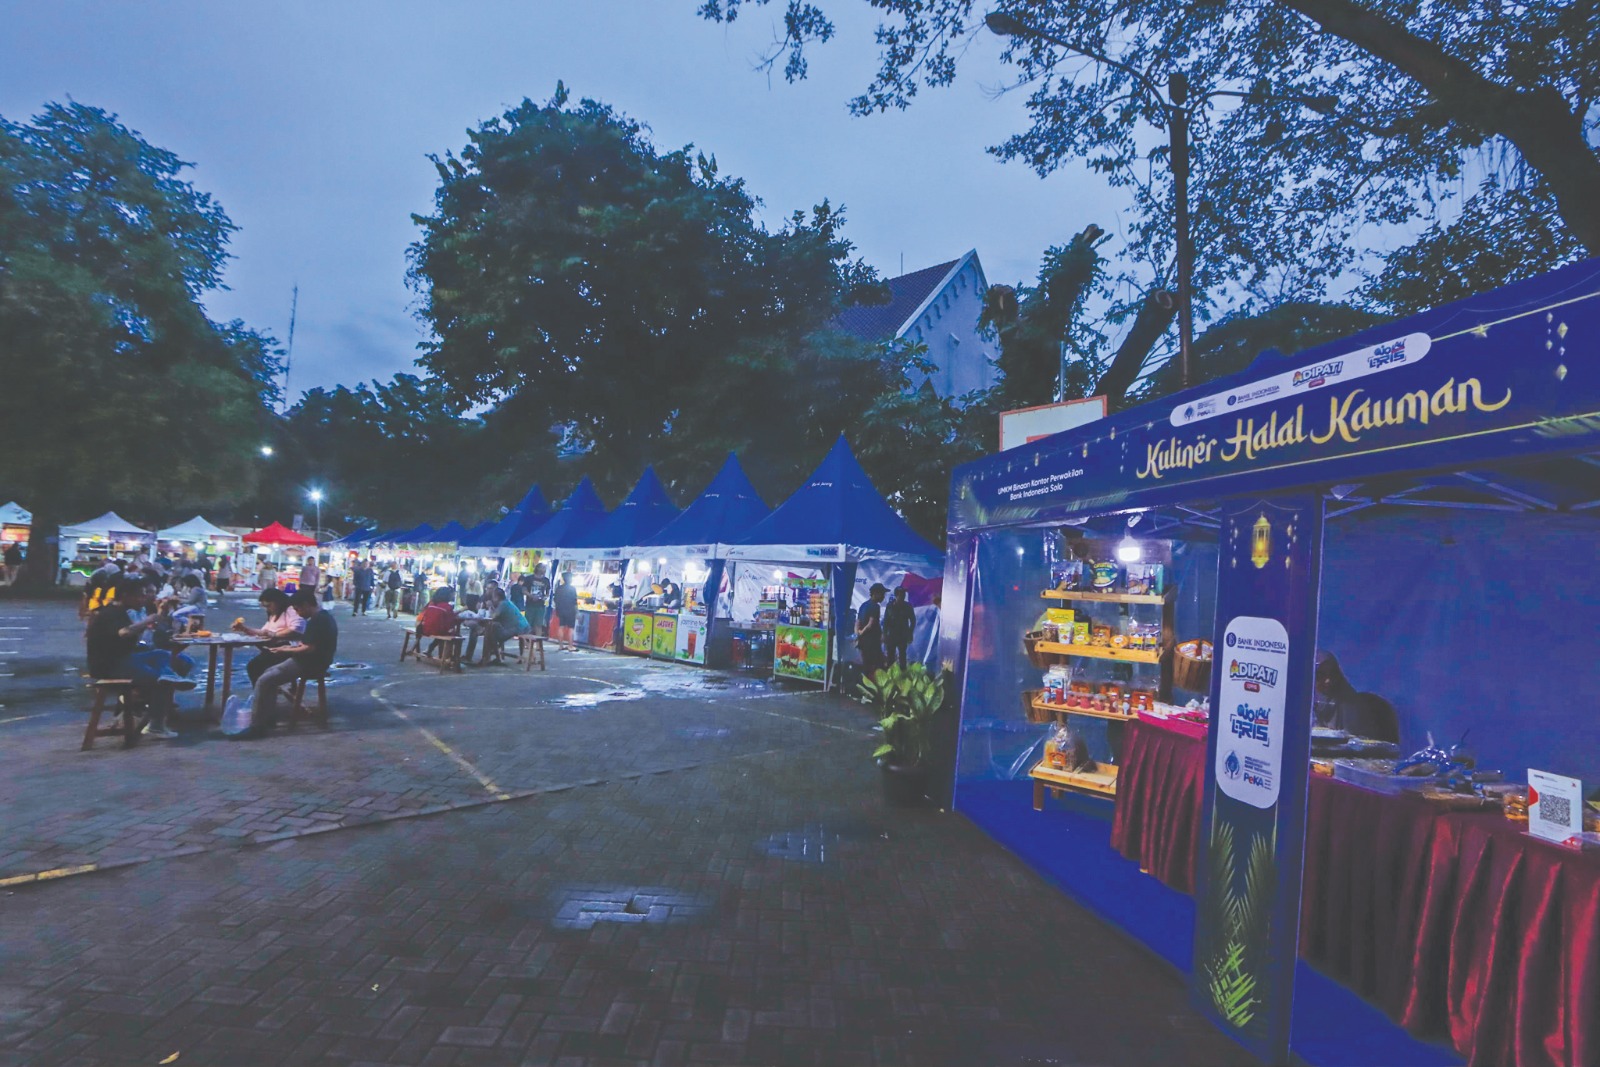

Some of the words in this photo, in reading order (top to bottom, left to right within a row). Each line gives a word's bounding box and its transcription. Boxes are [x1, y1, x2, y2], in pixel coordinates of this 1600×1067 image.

[1293, 361, 1343, 387] ADIPATI
[1251, 385, 1280, 398] INDONESIA
[1220, 404, 1308, 462] Halal
[1310, 377, 1512, 444] Kauman
[997, 486, 1012, 495] UMKM
[1013, 483, 1030, 491] Binaan
[1031, 478, 1049, 487] Kantor
[1050, 468, 1084, 482] Perwakilan
[1010, 492, 1022, 501] Bank
[1023, 486, 1049, 497] Indonesia
[1050, 483, 1063, 492] Solo
[1238, 637, 1253, 646] BANK
[1253, 639, 1287, 650] INDONESIA
[1230, 659, 1278, 686] ADIPATI
[1231, 719, 1268, 742] QRIS
[1243, 772, 1264, 787] PeKA
